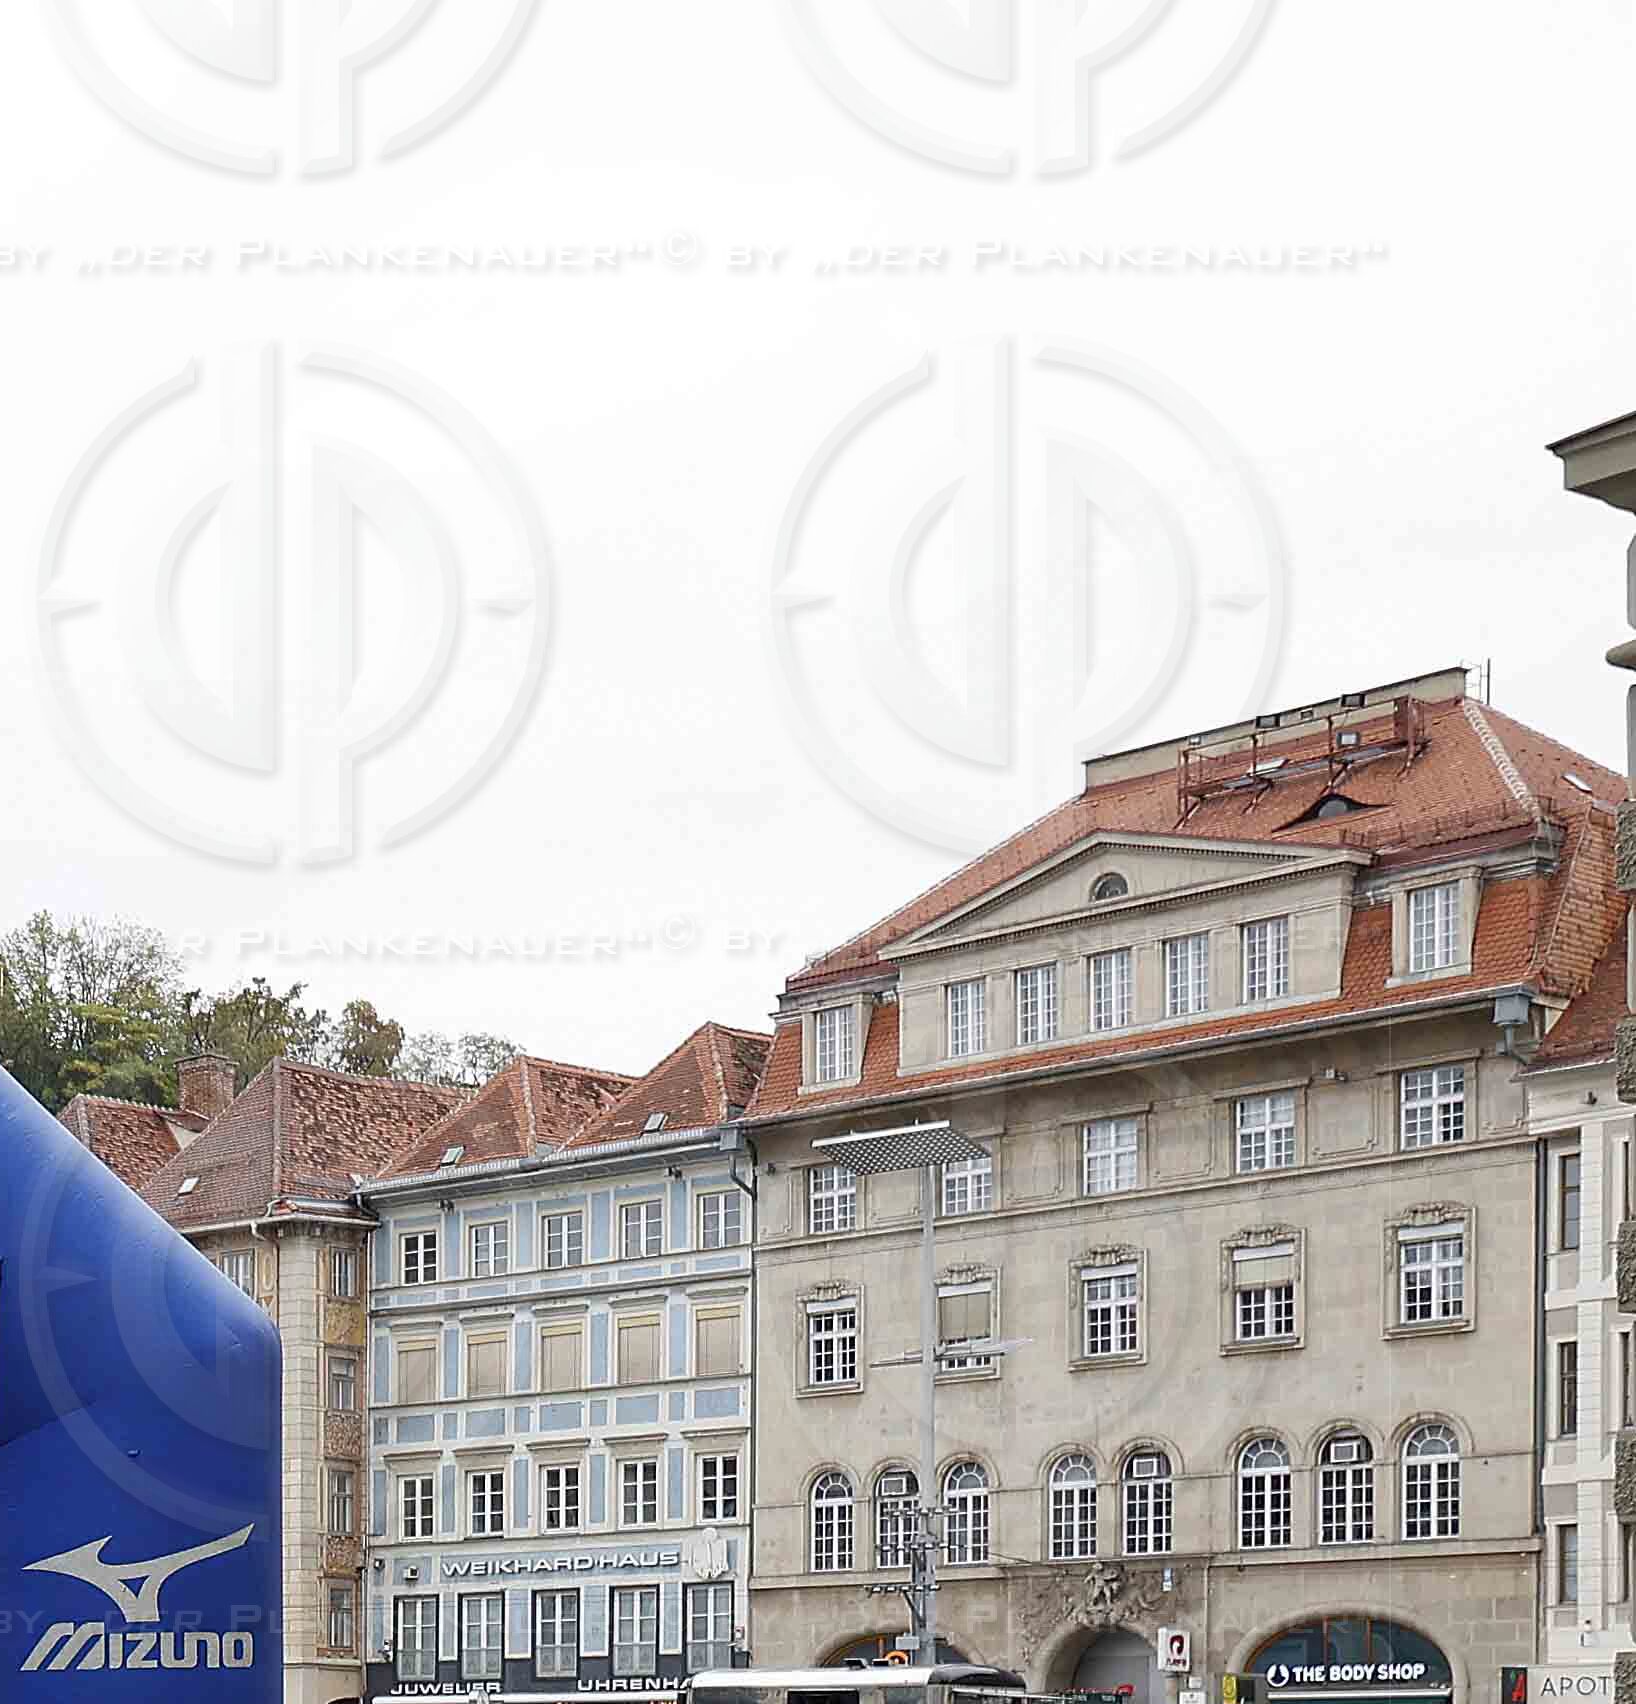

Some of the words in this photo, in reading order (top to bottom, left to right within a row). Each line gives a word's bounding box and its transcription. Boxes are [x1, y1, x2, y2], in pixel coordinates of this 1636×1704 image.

[1292, 1664, 1325, 1682] THE
[1329, 1663, 1375, 1682] BODY
[1377, 1662, 1425, 1681] SHOP
[1540, 1675, 1611, 1697] APOT
